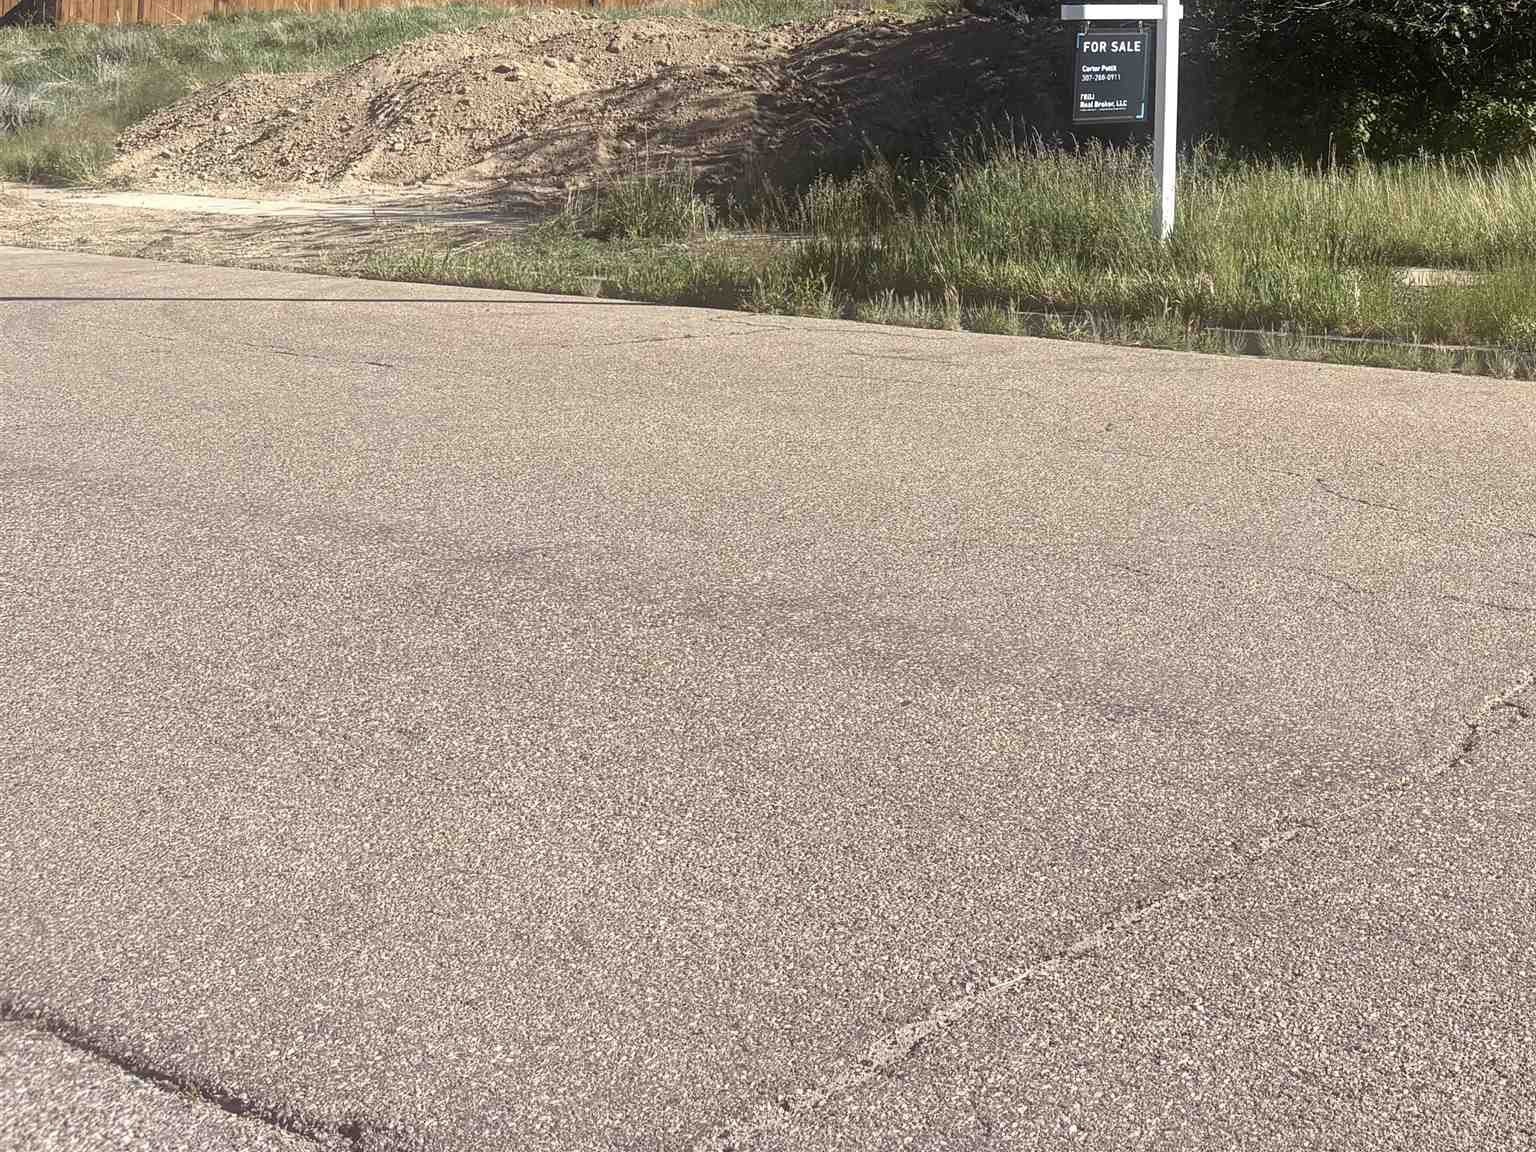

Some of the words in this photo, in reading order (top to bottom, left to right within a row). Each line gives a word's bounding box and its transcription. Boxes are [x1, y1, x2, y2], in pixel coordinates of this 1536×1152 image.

[1083, 41, 1107, 53] FOR
[1111, 40, 1141, 52] SALE
[1115, 99, 1128, 107] LLC
